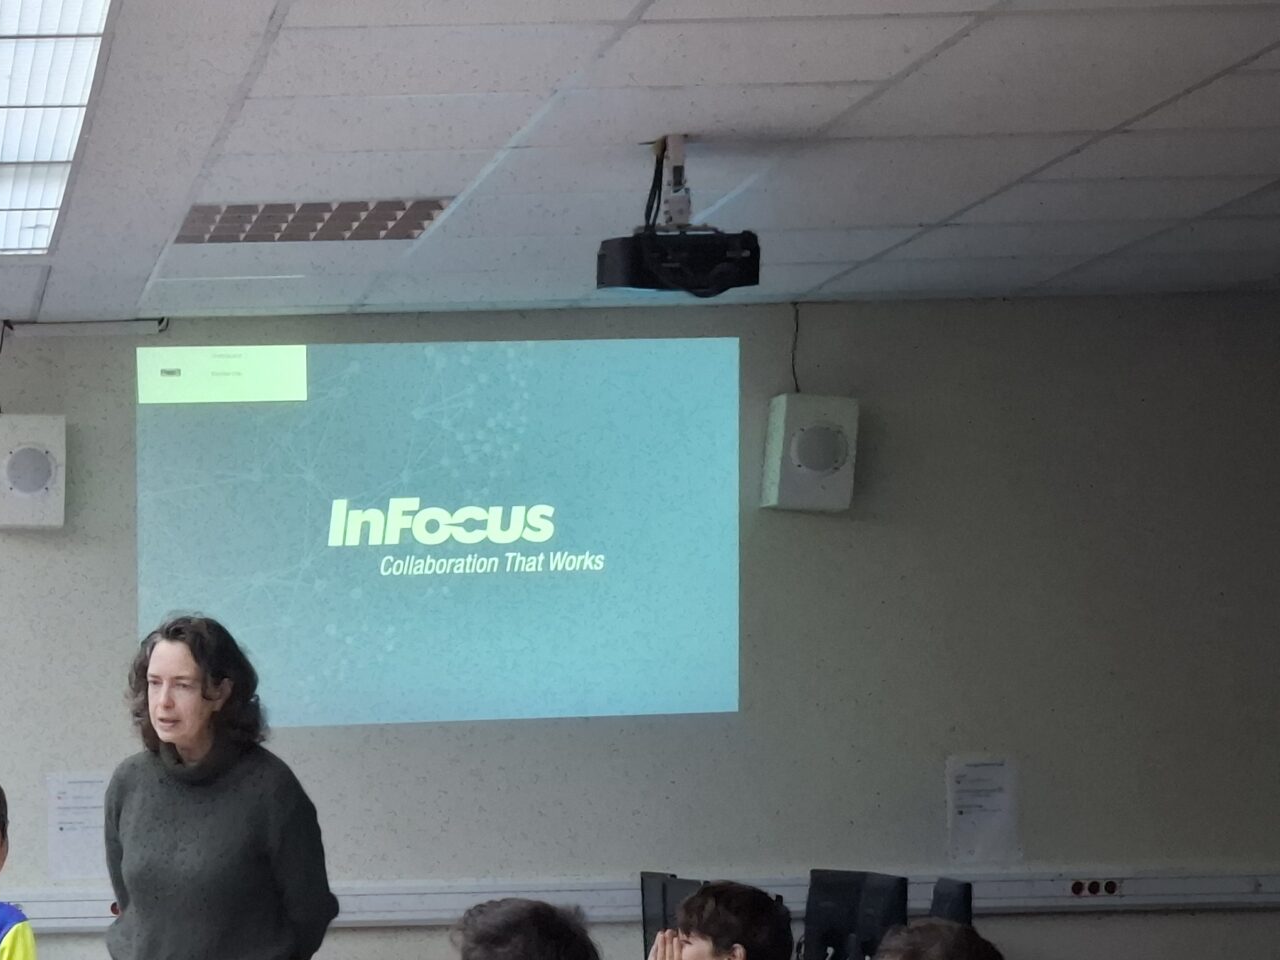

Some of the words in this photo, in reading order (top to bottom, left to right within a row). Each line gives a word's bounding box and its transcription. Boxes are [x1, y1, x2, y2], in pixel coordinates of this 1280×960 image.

[327, 497, 555, 547] InFocus
[380, 553, 498, 576] Collaboration
[504, 552, 543, 573] That
[549, 551, 605, 571] Works
